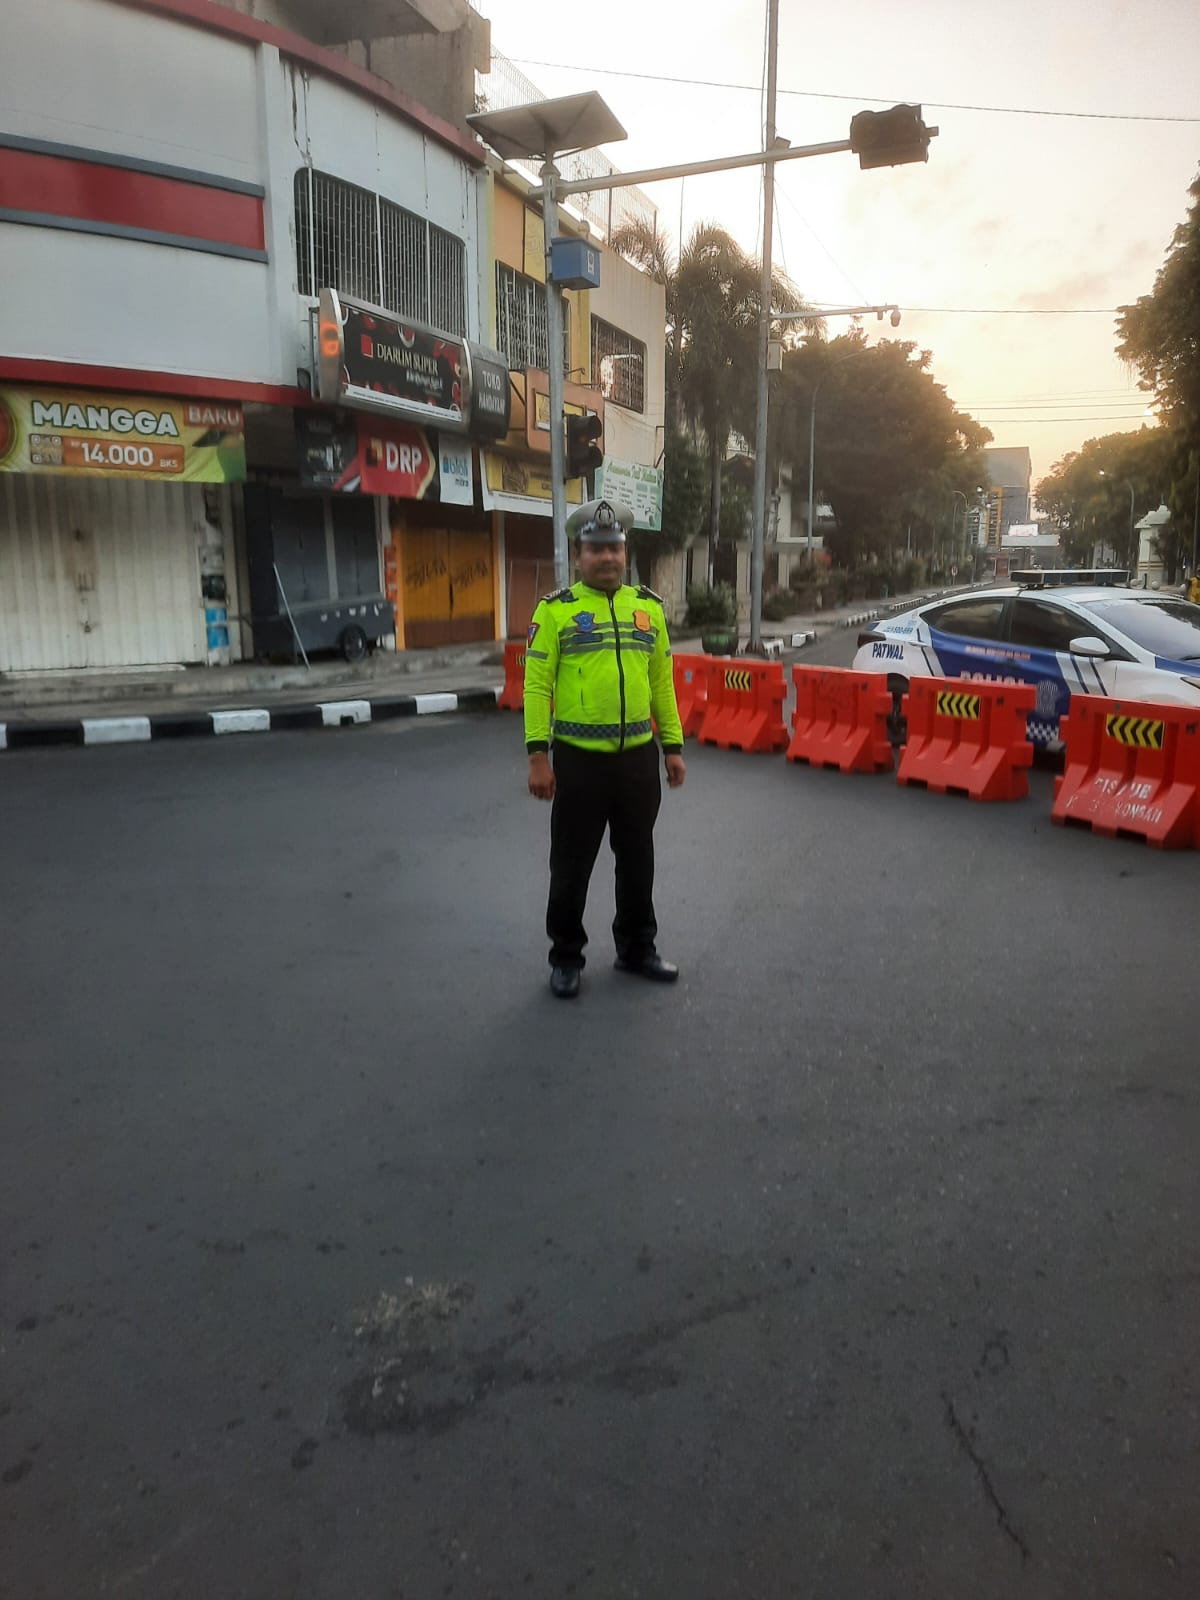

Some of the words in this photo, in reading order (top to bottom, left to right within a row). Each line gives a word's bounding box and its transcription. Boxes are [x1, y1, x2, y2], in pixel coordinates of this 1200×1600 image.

[377, 343, 412, 368] DJARUM
[413, 353, 439, 376] SUPER
[482, 370, 501, 391] TOKO
[32, 401, 179, 436] MANGGA
[188, 405, 240, 426] BARU
[81, 442, 154, 466] 14.000
[159, 458, 178, 468] BKS
[385, 441, 423, 474] DRP
[872, 643, 904, 660] PATWAL
